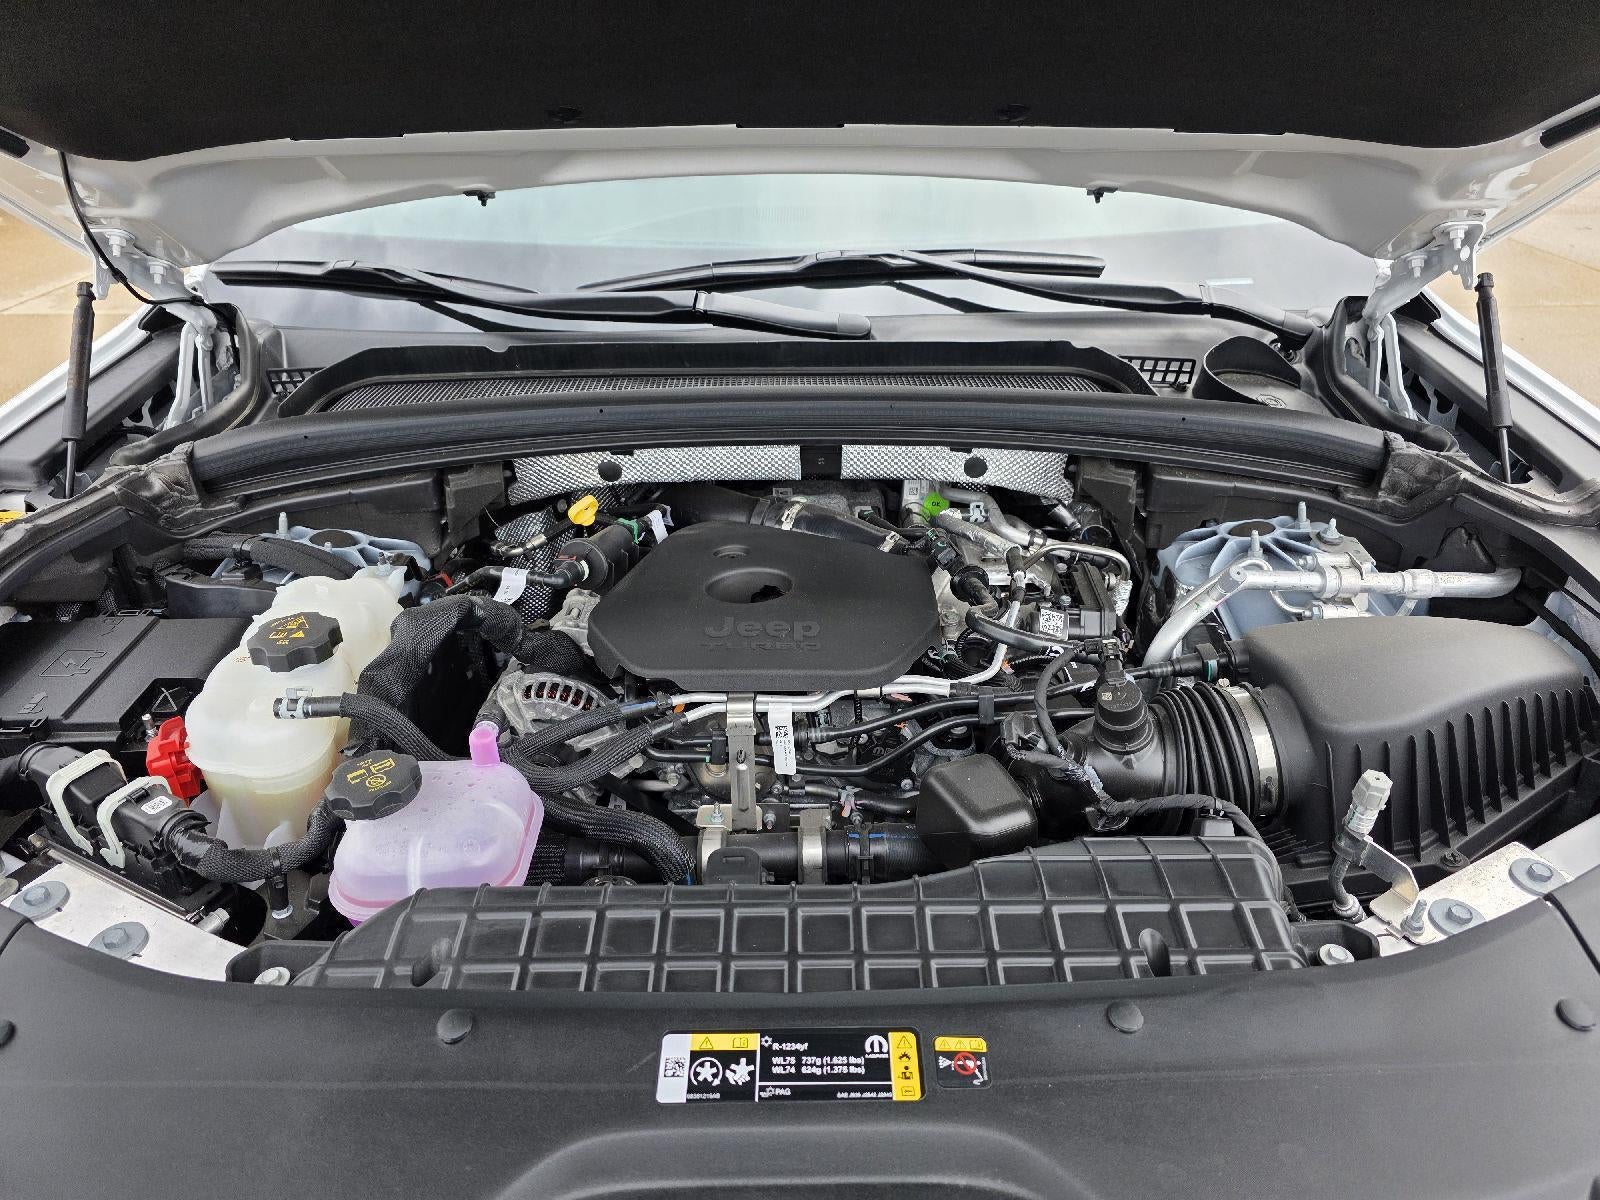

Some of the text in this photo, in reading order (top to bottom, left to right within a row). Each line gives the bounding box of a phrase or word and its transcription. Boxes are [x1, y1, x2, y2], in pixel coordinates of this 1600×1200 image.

[702, 616, 820, 641] Jeep
[772, 1042, 808, 1051] R-1234yf
[772, 1056, 796, 1065] WL75
[801, 1056, 821, 1066] 737g
[848, 1056, 865, 1065] lbs)
[772, 1066, 796, 1074] WL74
[849, 1065, 866, 1075] lbs)
[775, 1088, 791, 1096] PAG
